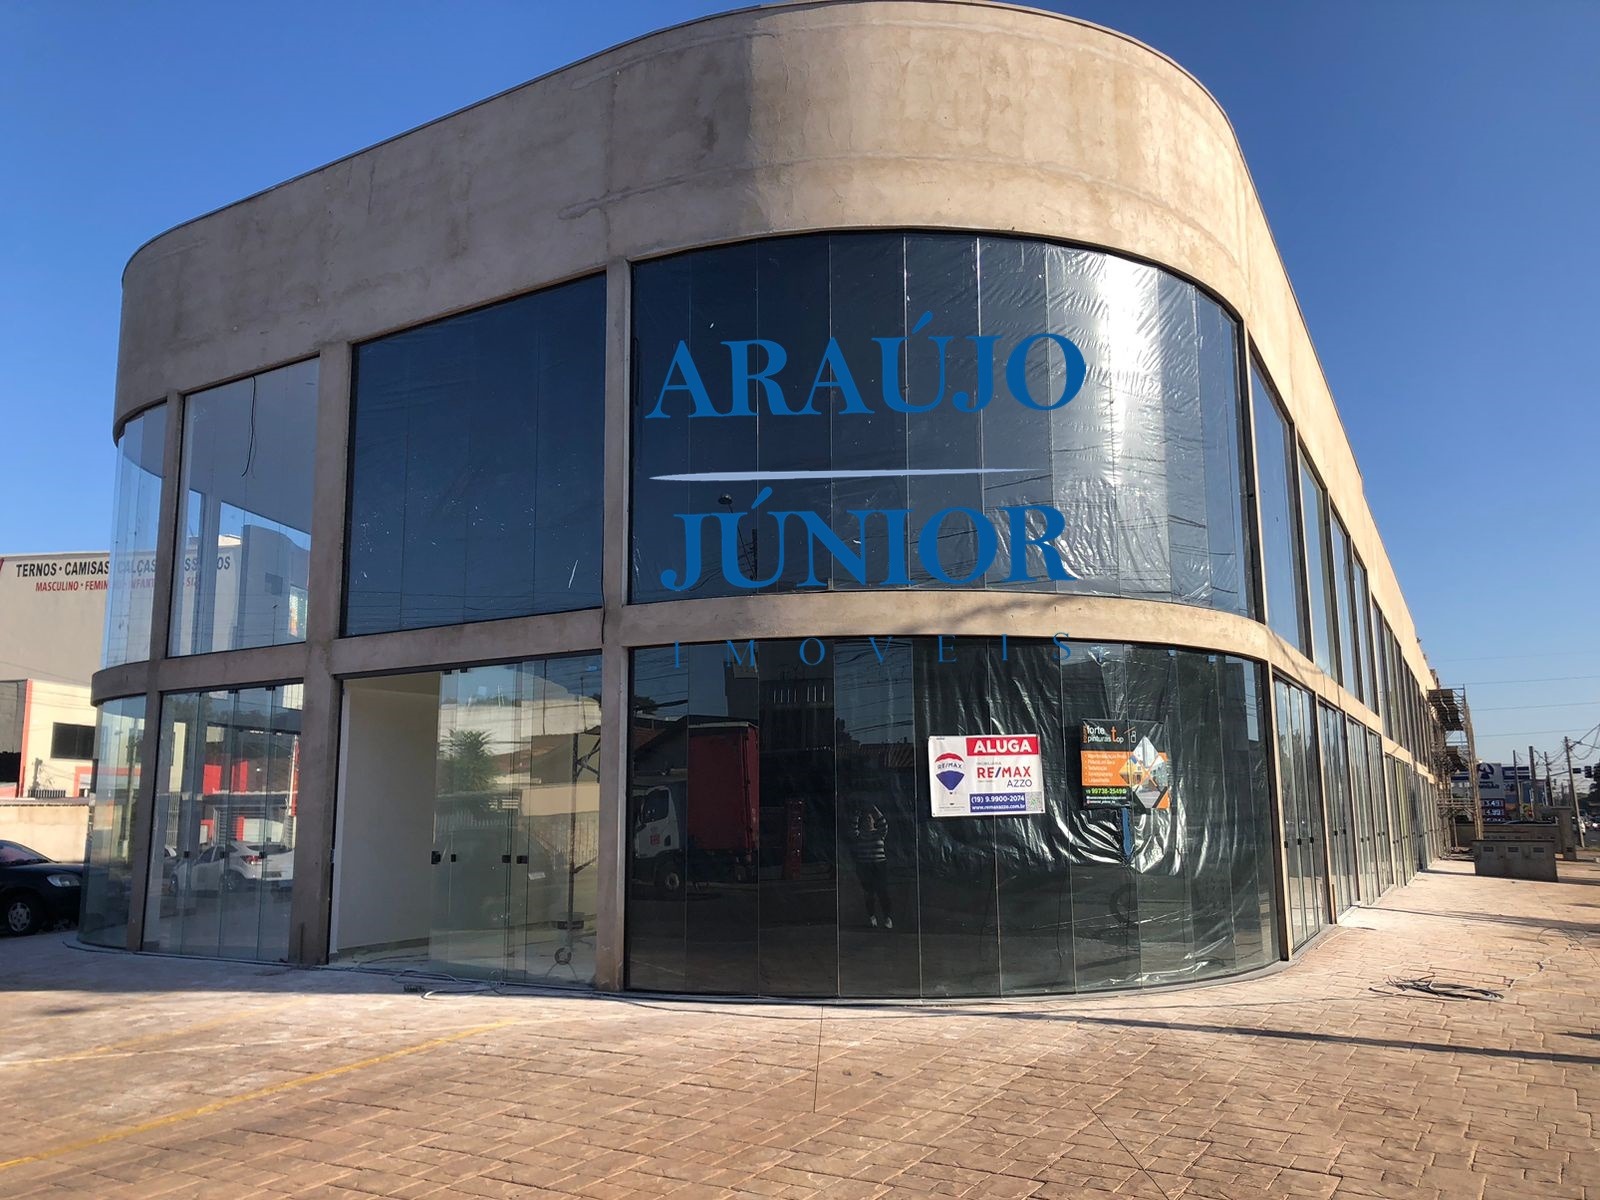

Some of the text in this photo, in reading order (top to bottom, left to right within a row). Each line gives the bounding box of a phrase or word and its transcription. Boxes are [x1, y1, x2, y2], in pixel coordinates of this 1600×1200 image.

[16, 563, 57, 578] TERNOS
[65, 561, 109, 576] CAMISAS
[36, 581, 79, 592] MASCULINO
[973, 739, 1032, 753] ALUGA
[937, 762, 962, 770] RE/MAX
[977, 766, 1031, 778] RE/MAX
[1007, 779, 1033, 788] AZZO
